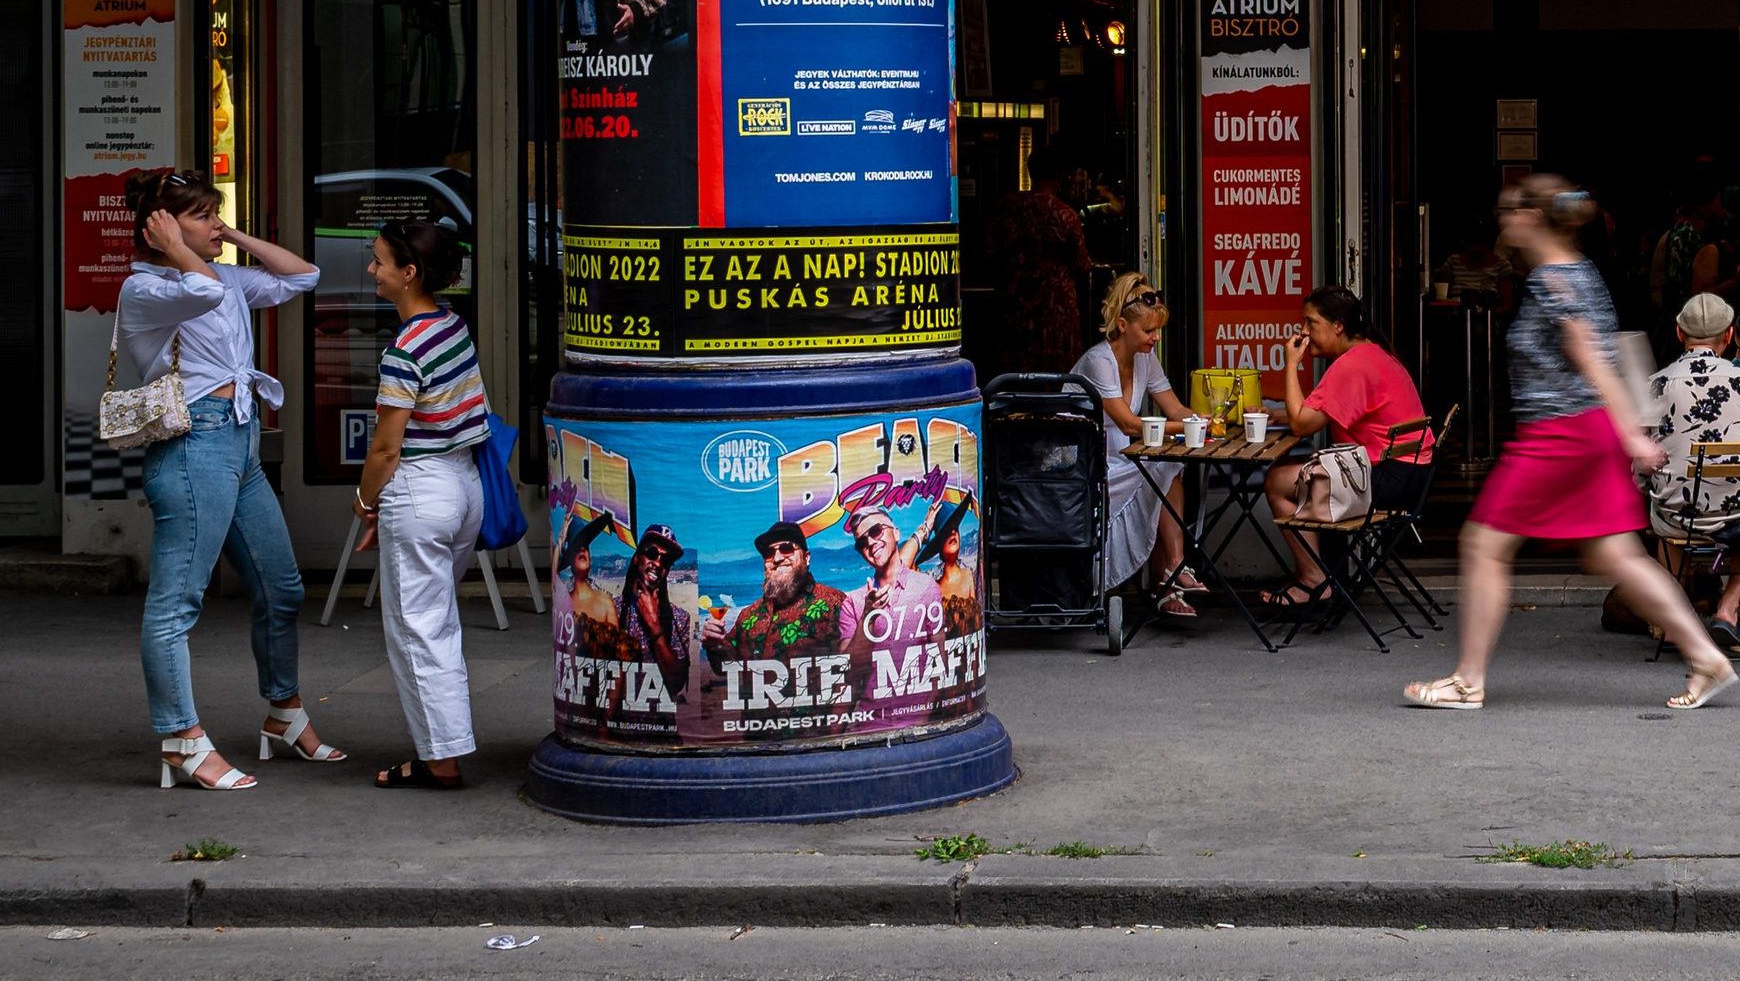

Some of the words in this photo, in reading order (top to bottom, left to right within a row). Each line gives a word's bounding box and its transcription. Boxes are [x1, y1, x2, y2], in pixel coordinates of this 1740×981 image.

[1211, 11, 1299, 37] BISZTRÓ
[83, 35, 156, 48] JEGYPÉNZTÁRI
[83, 49, 157, 62] NYITVATARTÁS
[586, 48, 653, 78] KÁROLY
[92, 70, 148, 80] munkanapokon
[794, 70, 830, 79] JEGYEK
[831, 68, 880, 79] VÁLTHATÓK:
[1212, 65, 1300, 79] KÍNÁLATUNKBÓL:
[793, 80, 806, 90] ÉS
[808, 81, 821, 90] AZ
[822, 80, 856, 90] ÖSSZES
[79, 104, 129, 115] munkaszüneti
[130, 106, 162, 116] napokon
[747, 108, 785, 126] ROCK
[821, 123, 853, 133] NATION
[1214, 110, 1300, 142] ÜDÍTŐK
[86, 141, 107, 151] online
[105, 132, 135, 143] nonstop
[775, 171, 856, 183] TOMJONES.COM
[1213, 168, 1301, 183] CUKORMENTES
[1214, 182, 1301, 206] LIMONÁDÉ
[719, 238, 774, 247] VAGYOK
[839, 238, 853, 246] AZ
[1214, 232, 1301, 251] SEGAFREDO
[609, 256, 660, 282] 2022
[685, 256, 714, 281] EZ
[726, 255, 761, 281] AZ
[773, 254, 791, 280] A
[804, 251, 865, 280] NAP!
[875, 249, 948, 278] STADION
[1214, 250, 1302, 296] KÁVÉ
[685, 283, 829, 310] PUSKÁS
[851, 280, 939, 307] ARÉNA
[623, 315, 660, 337] 23.
[902, 305, 955, 331] JÚLIUS
[1216, 323, 1302, 340] ALKOHOLOS
[704, 339, 758, 348] MODERN
[768, 338, 818, 347] GOSPEL
[827, 337, 865, 346] NAPJA
[719, 438, 770, 458] BUDAPEST
[719, 455, 771, 483] PARK
[838, 464, 949, 533] Party
[863, 601, 949, 643] 07.29.
[721, 653, 852, 711] IRIE
